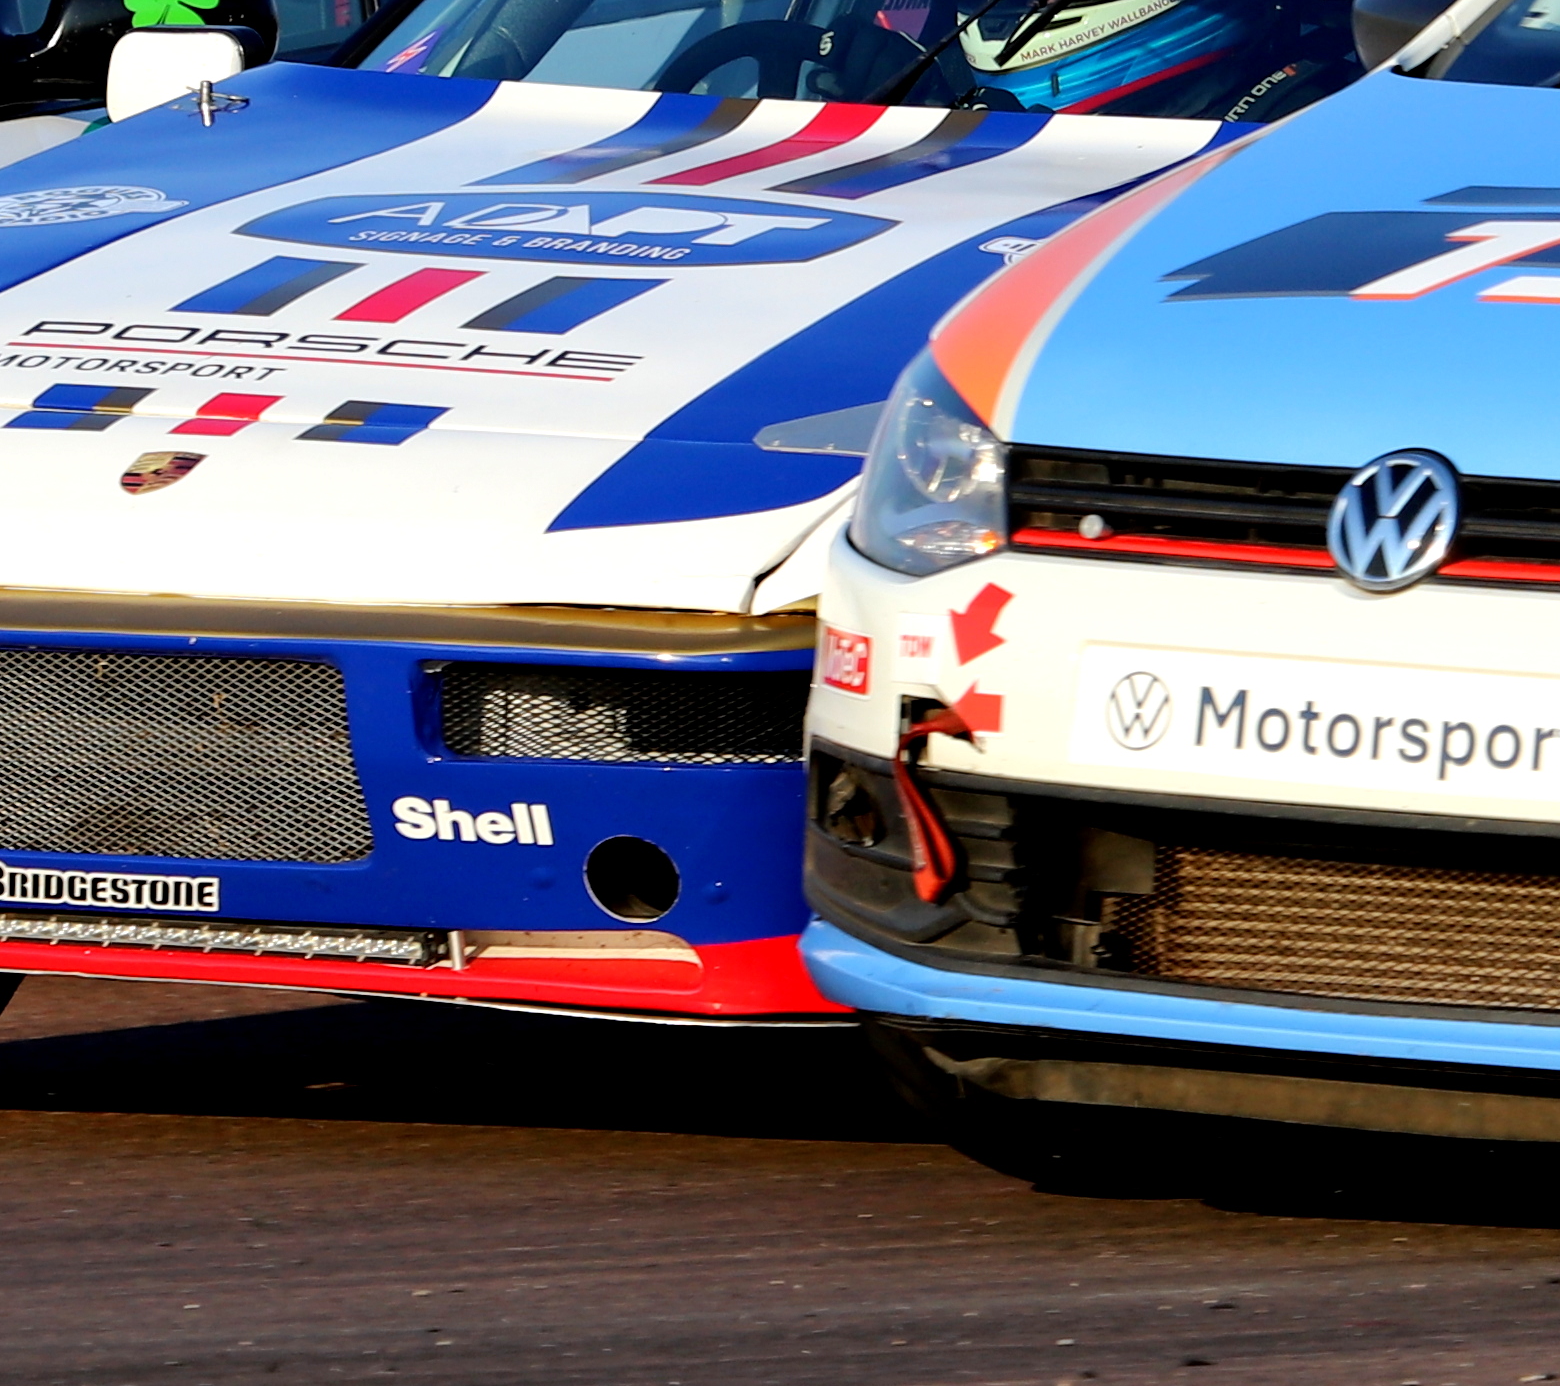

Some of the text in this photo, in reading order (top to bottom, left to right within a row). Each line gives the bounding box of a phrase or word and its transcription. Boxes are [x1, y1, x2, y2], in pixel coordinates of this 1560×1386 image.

[1020, 42, 1058, 63] MARK
[1057, 23, 1107, 53] HARVEY
[348, 229, 693, 262] SIGNAGE & BRANDING
[18, 320, 646, 372] PORSCHE
[392, 795, 555, 847] Shell
